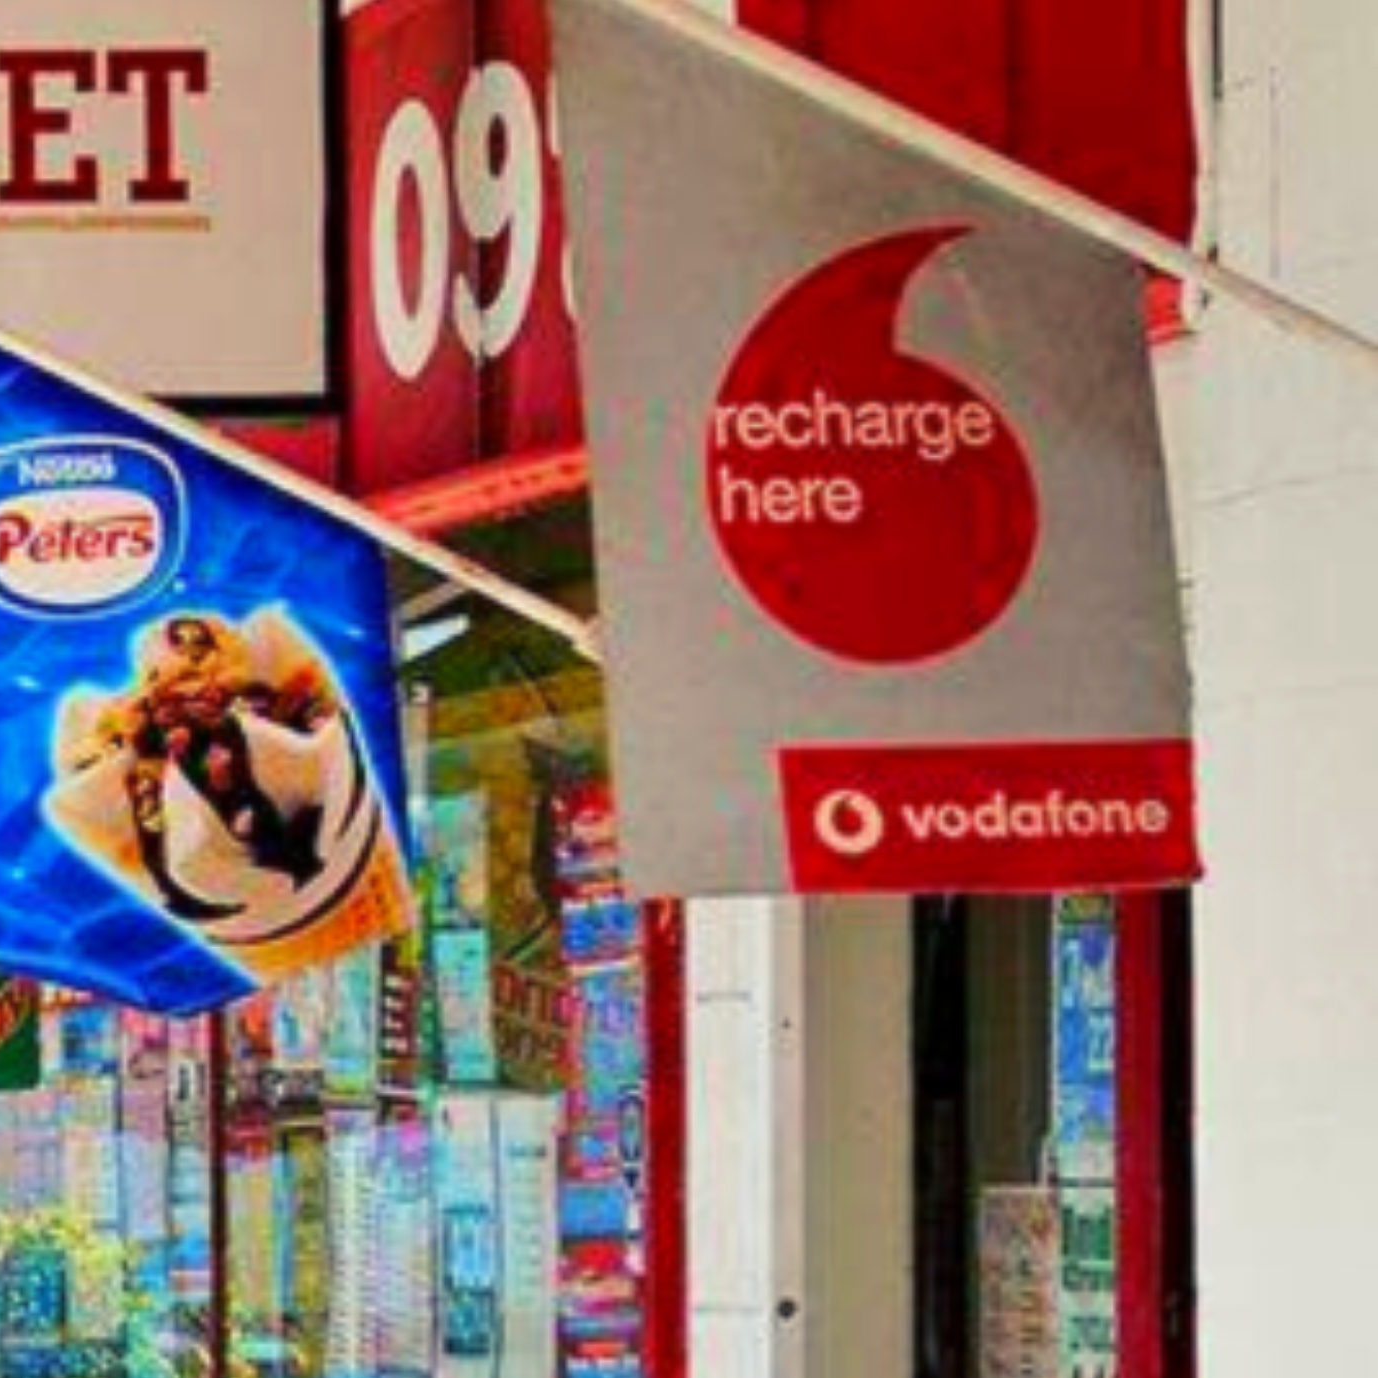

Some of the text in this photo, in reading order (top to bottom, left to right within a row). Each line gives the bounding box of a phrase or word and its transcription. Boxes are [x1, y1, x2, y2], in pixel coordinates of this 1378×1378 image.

[370, 60, 578, 380] 09
[714, 390, 994, 462] recharge
[719, 467, 862, 523] here
[903, 791, 1169, 842] vodafone
